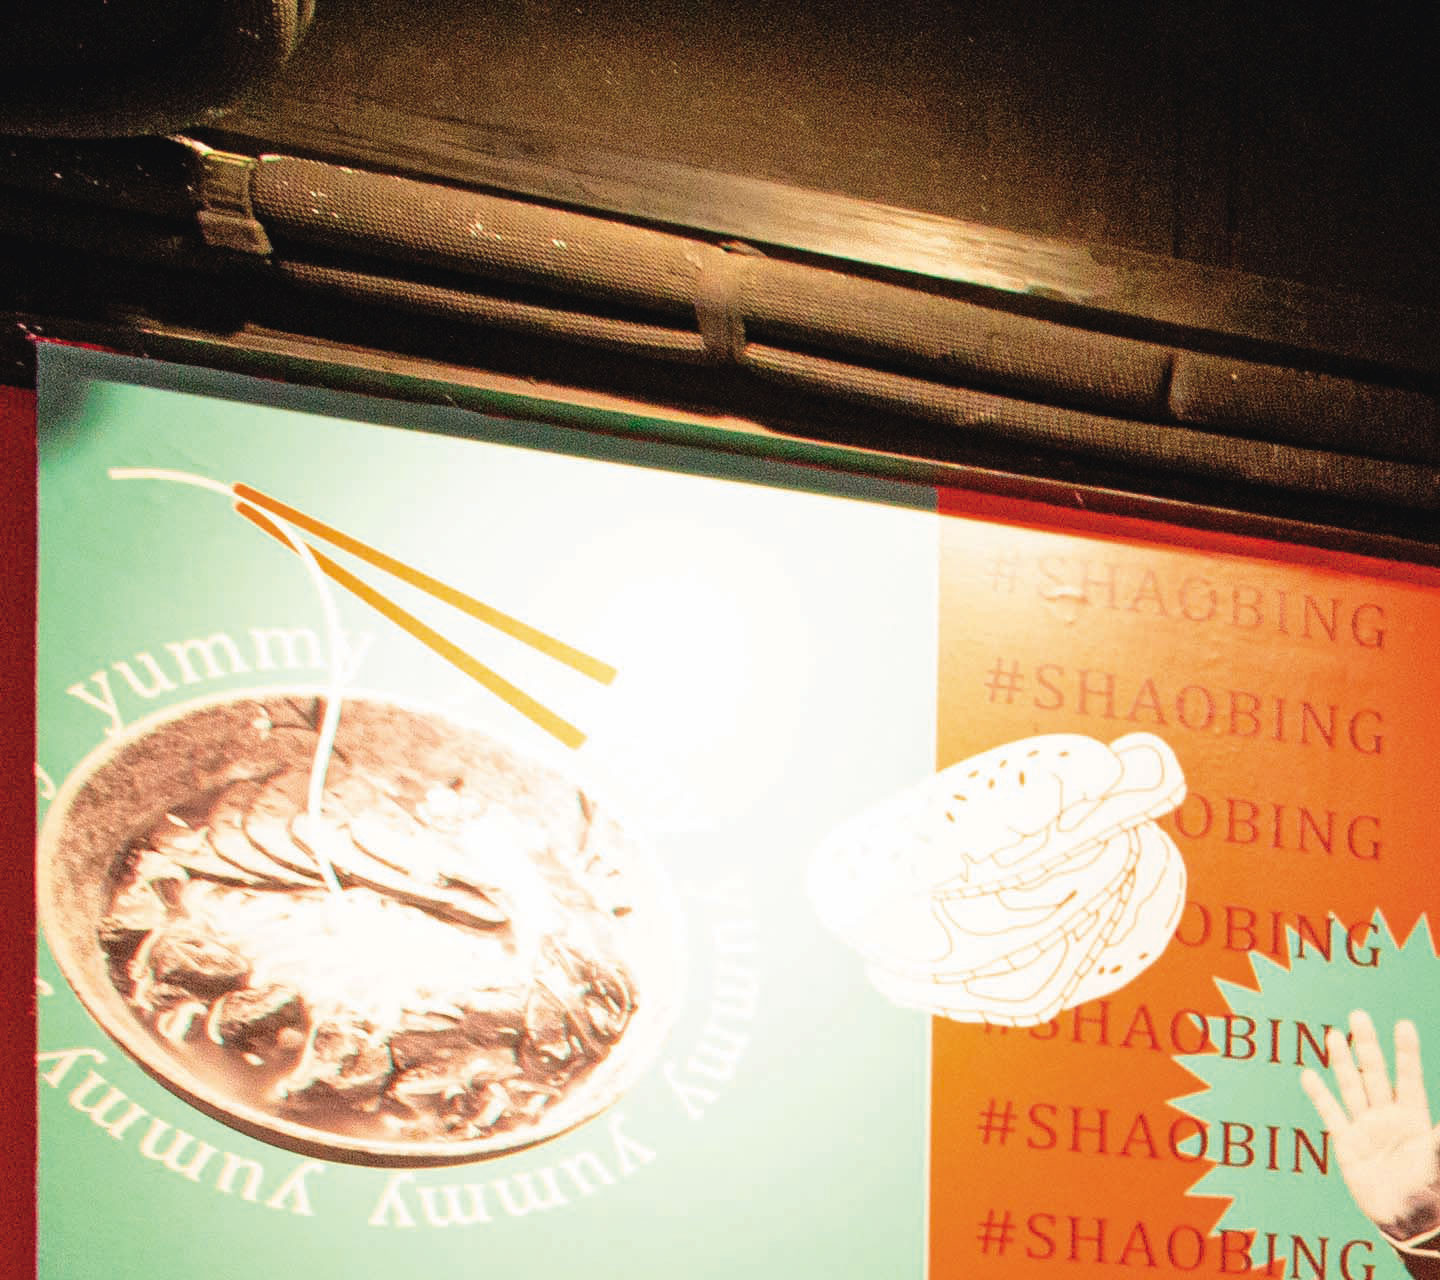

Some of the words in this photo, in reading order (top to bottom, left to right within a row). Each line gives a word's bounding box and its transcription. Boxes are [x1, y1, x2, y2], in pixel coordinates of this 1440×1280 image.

[985, 552, 1387, 650] #SHAOBING
[985, 657, 1387, 757] #SHAOBING
[1172, 792, 1384, 862] OBING
[37, 1044, 324, 1219] yummy
[369, 1113, 656, 1229] yummy
[978, 1098, 1330, 1175] #SHAOBIN
